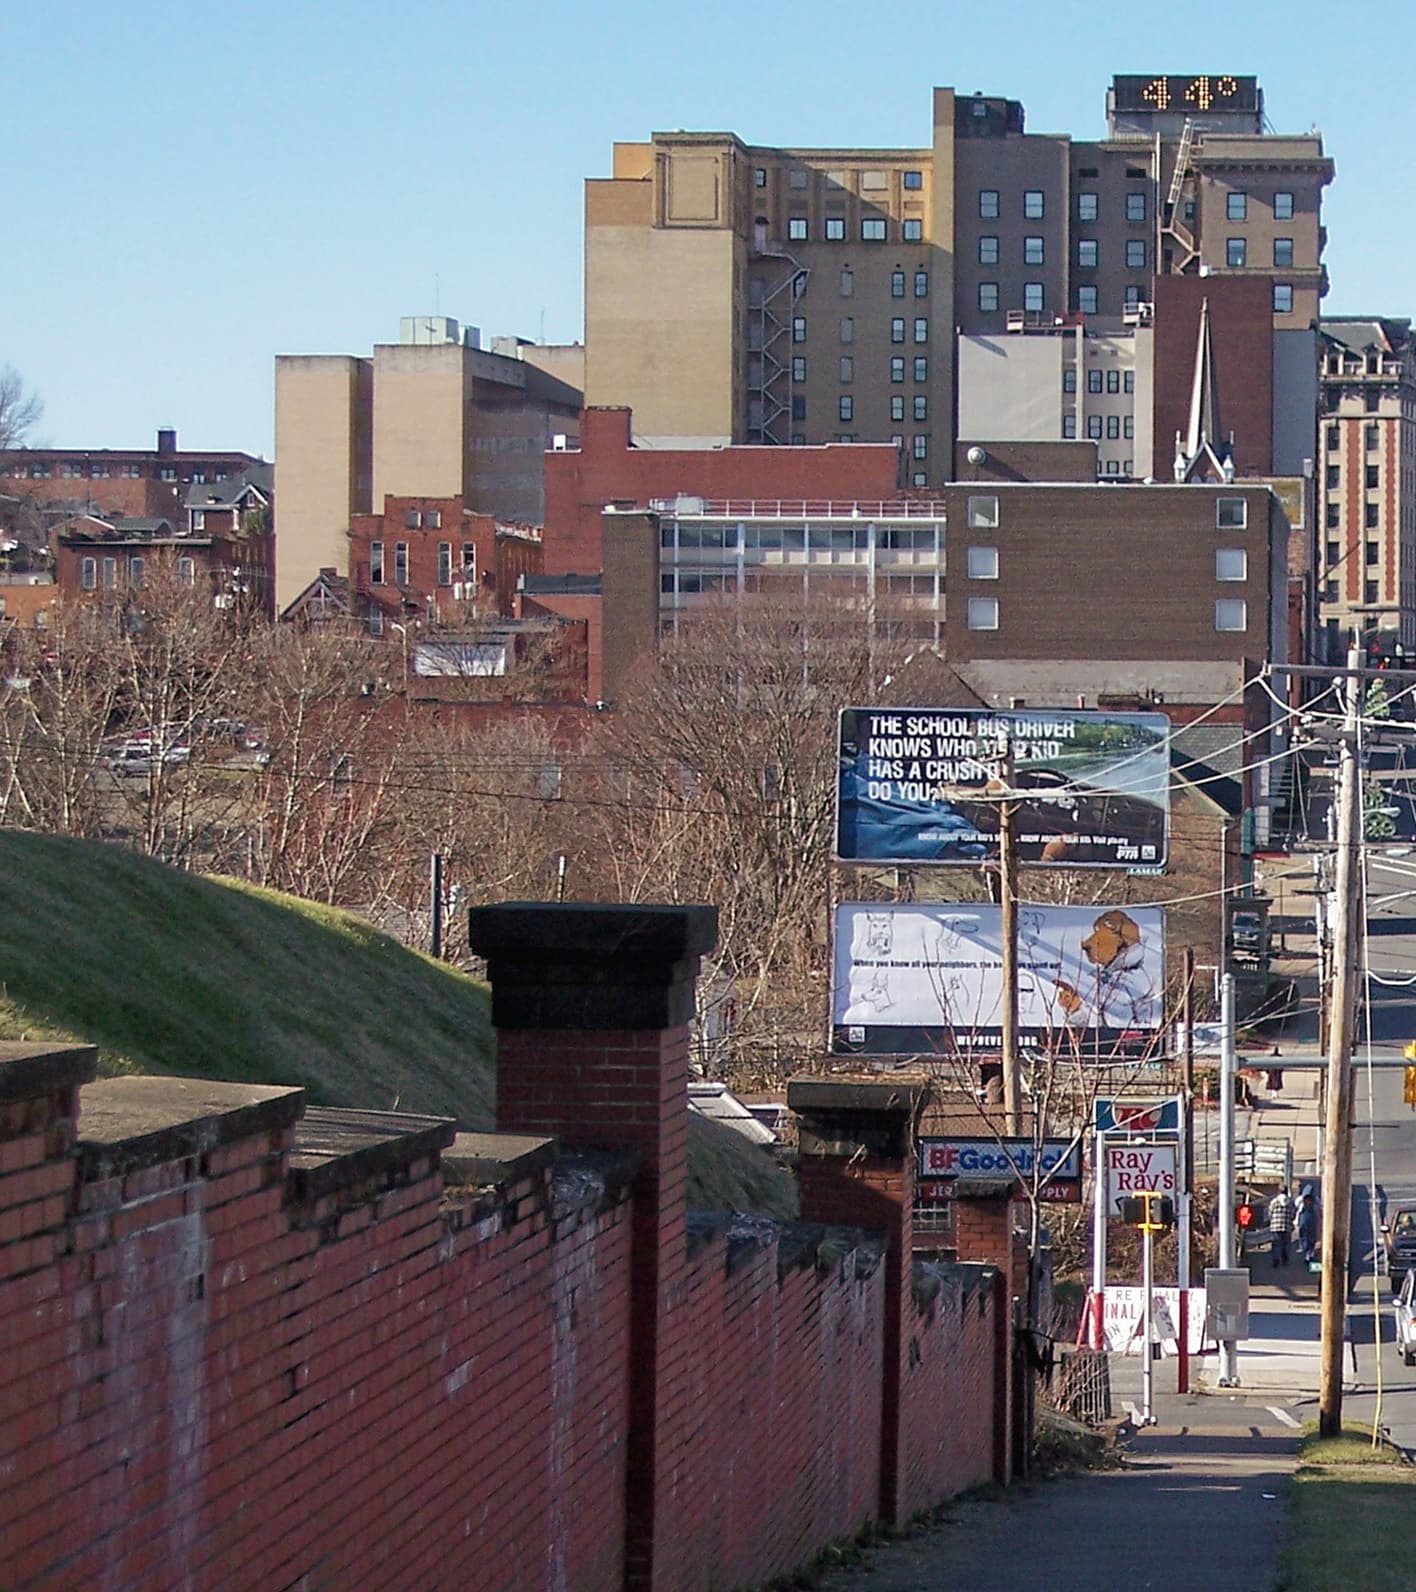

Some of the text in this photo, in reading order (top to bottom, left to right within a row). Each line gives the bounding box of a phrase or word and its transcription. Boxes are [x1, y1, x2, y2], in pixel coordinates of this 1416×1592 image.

[870, 716, 1075, 738] THE SCHOOL BUS DRIVER
[869, 738, 932, 757] KNOWS
[937, 739, 977, 757] WHO
[1031, 741, 1061, 759] KID
[868, 760, 904, 778] HAS
[909, 761, 922, 779] A
[926, 761, 983, 780] CRUSH
[868, 781, 892, 799] DO
[1110, 1150, 1153, 1173] Ray
[1117, 1169, 1174, 1191] Ray's
